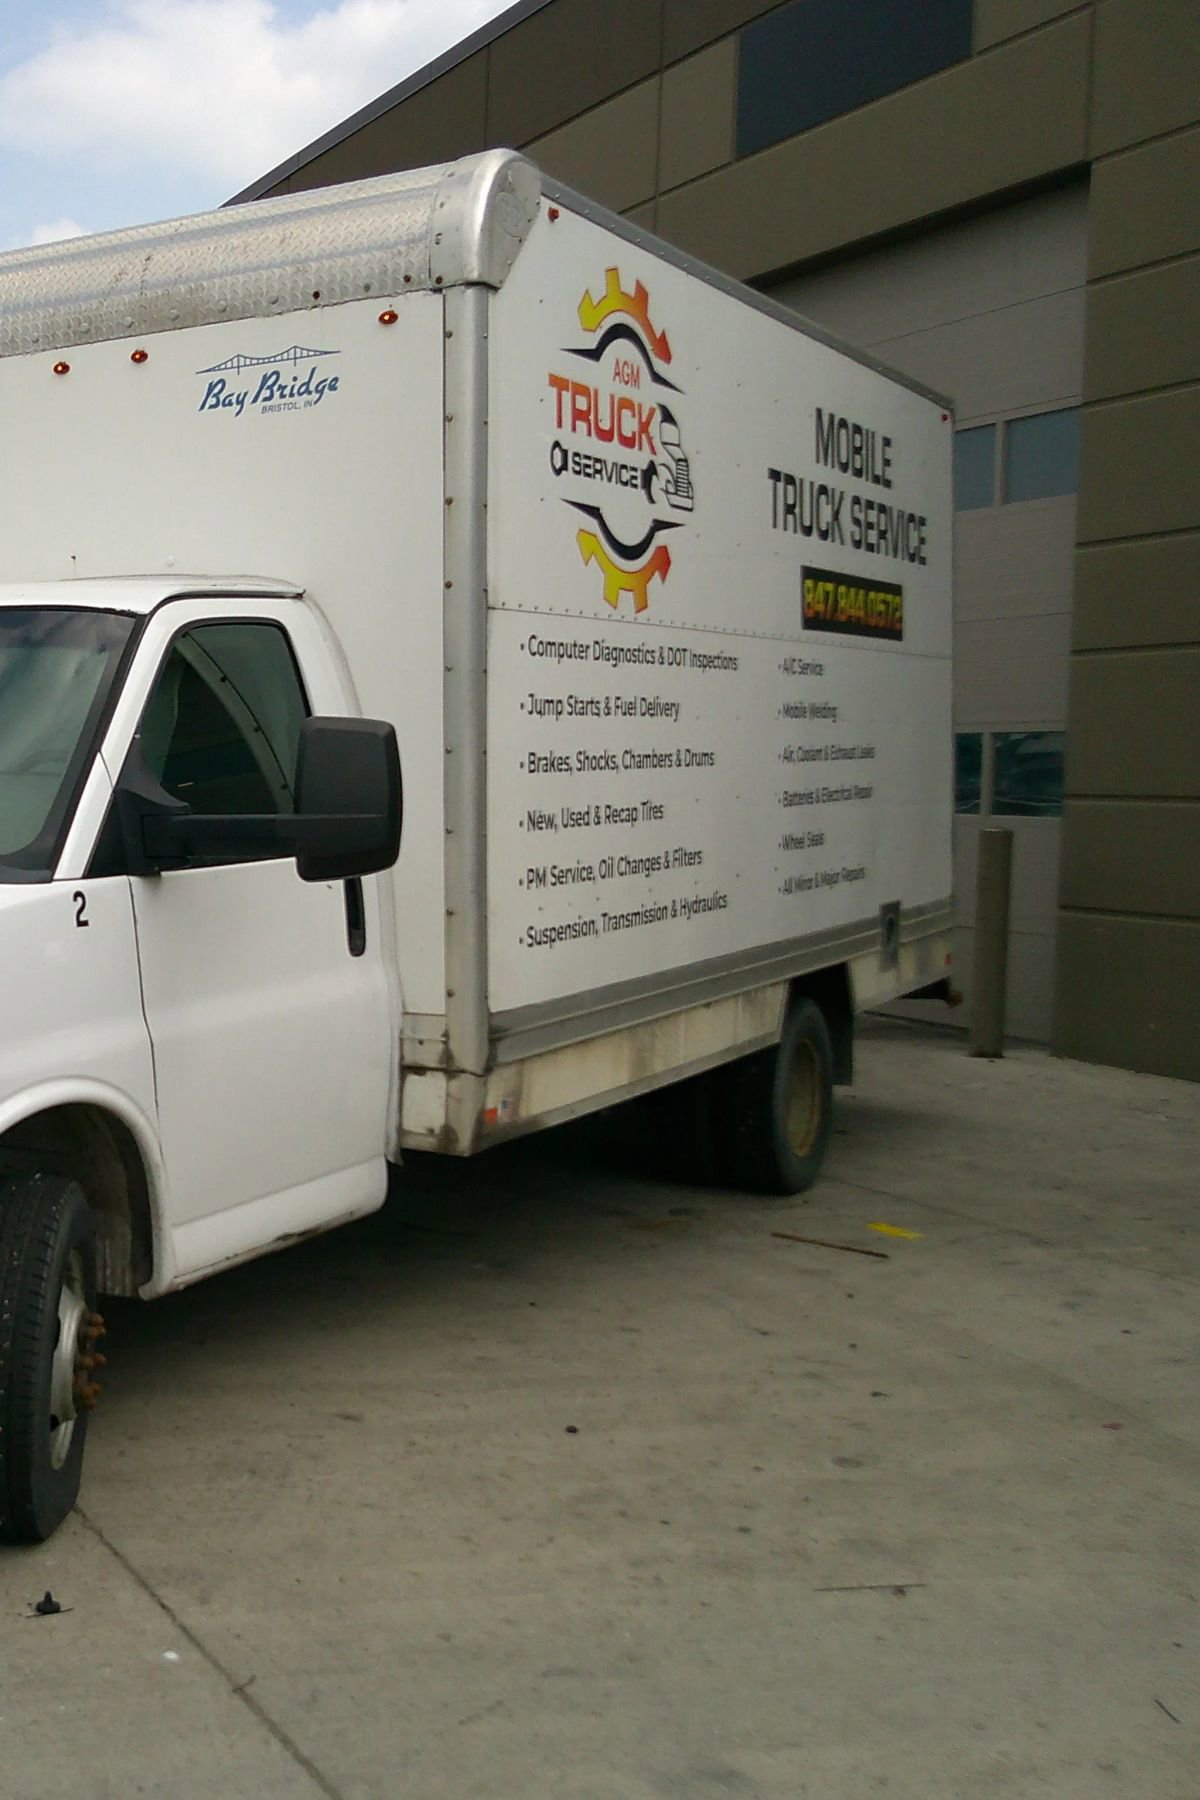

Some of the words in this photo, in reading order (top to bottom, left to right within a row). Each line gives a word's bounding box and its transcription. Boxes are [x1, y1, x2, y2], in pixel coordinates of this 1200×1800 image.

[198, 378, 249, 417] Bay
[250, 366, 339, 406] Bridge
[613, 358, 640, 389] AGM
[303, 399, 314, 409] IN
[548, 373, 657, 456] TRUCK
[816, 407, 892, 489] MOBILE
[572, 451, 639, 489] SERVICE
[767, 467, 845, 546] TRUCK
[850, 495, 927, 565] SERVICE
[528, 634, 590, 664] Computer
[592, 639, 655, 668] Diagnostics
[658, 646, 665, 665] &
[667, 647, 688, 666] DOT
[689, 650, 739, 673] Inspections
[527, 693, 563, 721] Jump
[567, 695, 600, 717] Starts
[603, 696, 611, 716] &
[614, 696, 637, 717] Fuel
[640, 696, 680, 722] Delivery
[528, 751, 572, 774] Brakes,
[576, 750, 618, 774] Shocks,
[622, 749, 673, 770] Chambers
[675, 749, 682, 767] &
[685, 749, 715, 767] Drums
[527, 810, 557, 833] New,
[561, 805, 589, 828] Used
[593, 806, 601, 826] &
[605, 804, 638, 828] Recap
[641, 800, 664, 821] Tires
[526, 868, 547, 890] PM
[550, 859, 596, 887] Service,
[599, 856, 614, 880] Oil
[617, 854, 662, 878] Changes
[664, 851, 670, 870] &
[673, 847, 703, 869] Filters
[73, 890, 89, 927] 2
[526, 914, 598, 949] Suspension,
[601, 901, 668, 933] Transmission
[671, 900, 677, 918] &
[680, 890, 728, 921] Hydraulics
